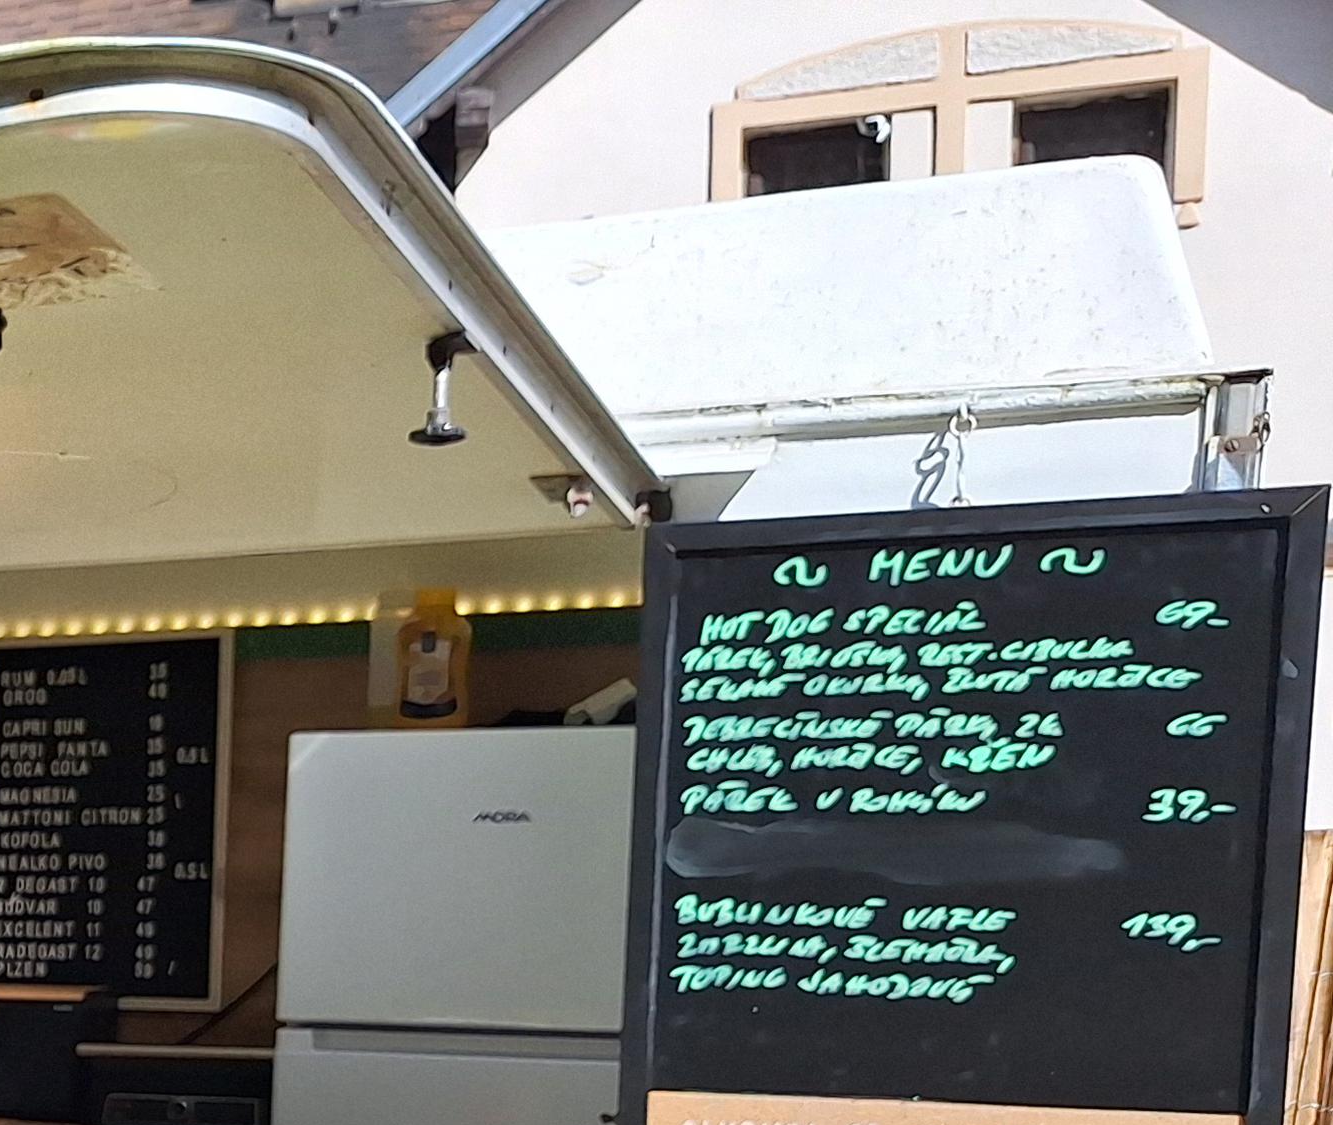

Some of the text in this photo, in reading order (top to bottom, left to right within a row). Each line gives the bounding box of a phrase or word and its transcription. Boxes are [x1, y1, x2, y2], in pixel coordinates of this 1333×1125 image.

[868, 544, 1014, 586] MENU
[700, 611, 764, 646] HOT
[765, 608, 834, 643] DOG
[842, 600, 986, 635] SPECIÁL
[0, 670, 36, 687] RUM
[2, 687, 48, 707] GROG
[2, 719, 47, 738] CAPRI
[53, 718, 86, 736] SUN
[0, 741, 44, 760] PEPSI
[57, 739, 109, 758] FANTA
[0, 760, 44, 778] COCA
[50, 759, 89, 777] COLA
[0, 786, 77, 805] MAGNESIA
[81, 807, 143, 826] CITRON
[471, 811, 532, 824] MORA
[0, 831, 61, 848] KOFOLA
[68, 853, 107, 871] PIVO
[88, 876, 106, 894] 10
[136, 876, 156, 892] 47
[87, 899, 104, 915] 10
[136, 899, 156, 915] 47
[674, 894, 887, 928] BUBLINKOVÉ
[902, 906, 1017, 930] VAFLE
[85, 943, 102, 961] 12
[669, 965, 788, 993] TOPING
